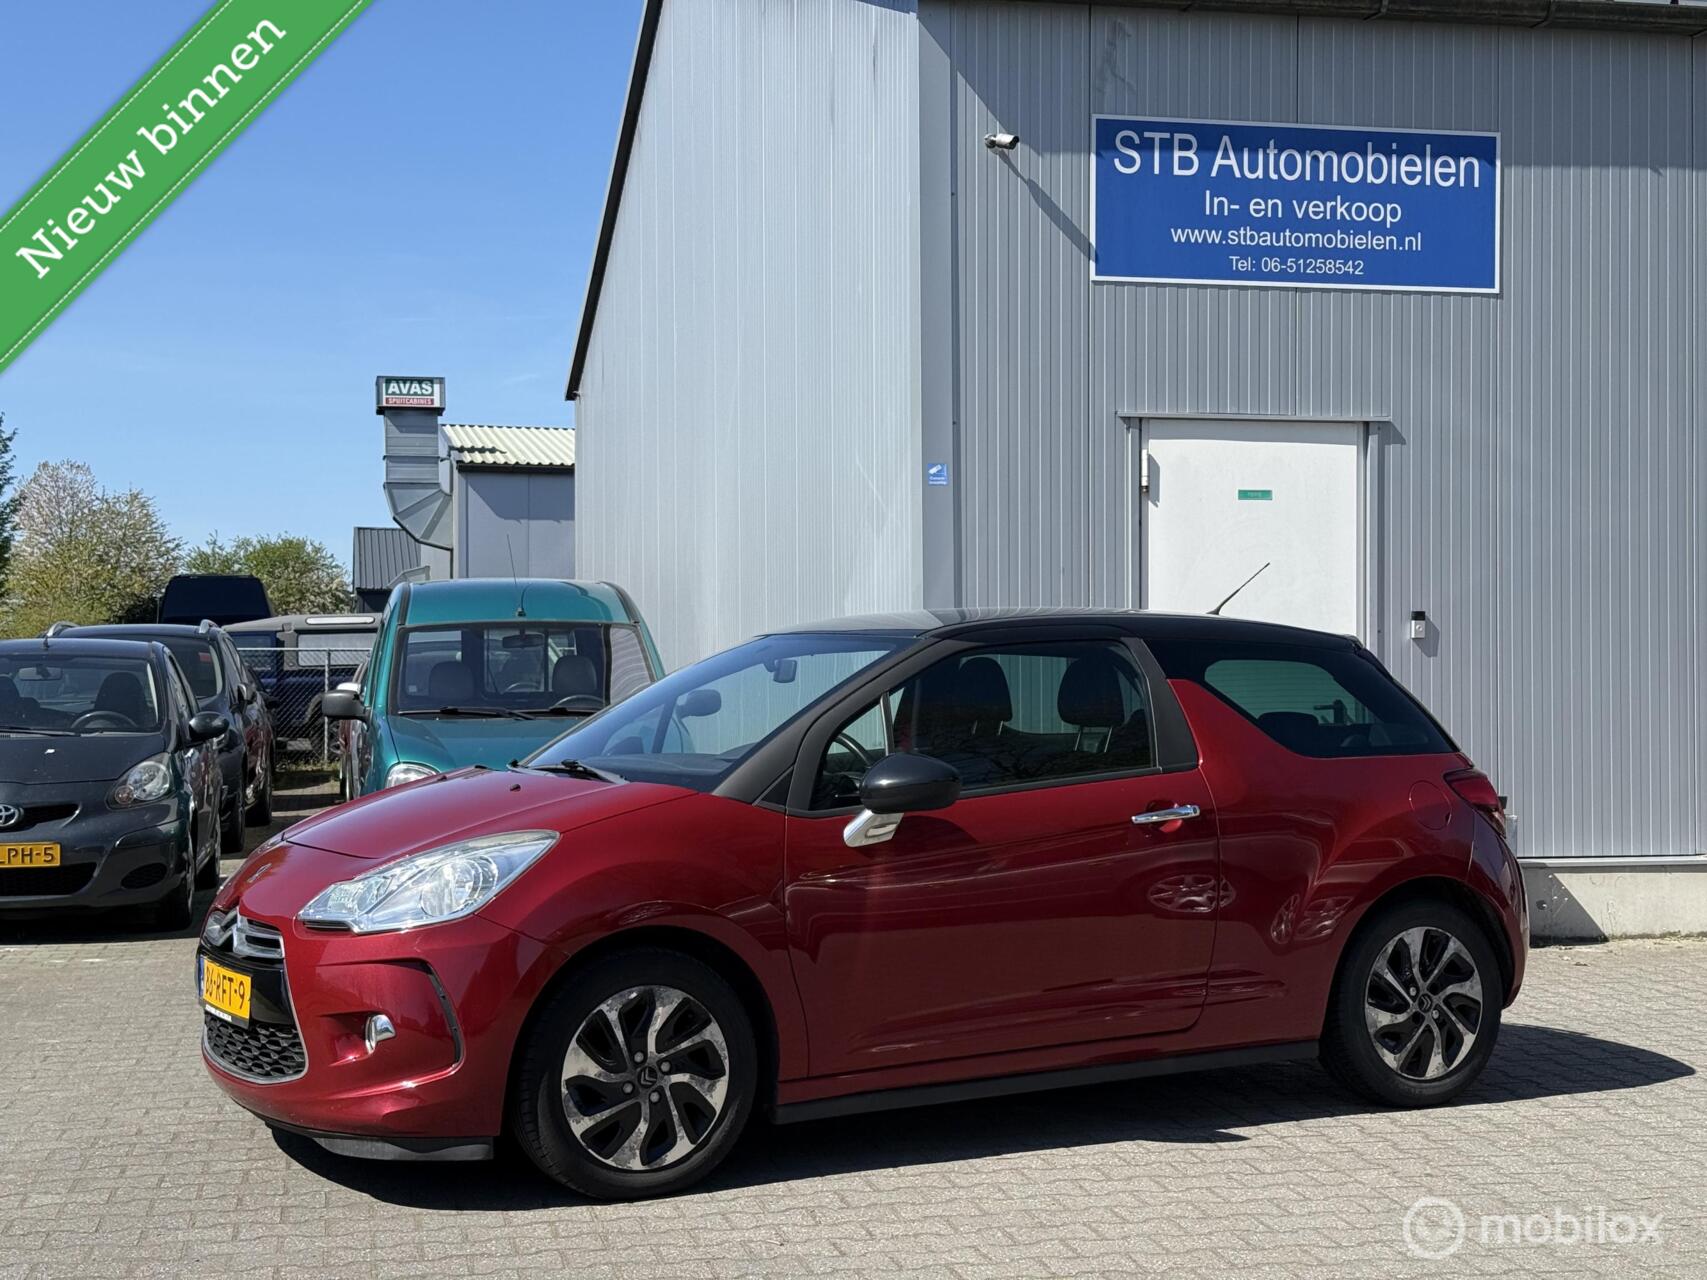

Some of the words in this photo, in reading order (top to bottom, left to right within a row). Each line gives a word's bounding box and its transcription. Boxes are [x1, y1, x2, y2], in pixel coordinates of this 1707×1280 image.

[1113, 130, 1200, 176] STB
[1211, 135, 1480, 188] Automobielen
[1204, 190, 1240, 217] In-
[1249, 197, 1283, 219] en
[1293, 196, 1402, 228] verkoop
[1170, 227, 1422, 252] www.stbautomobielen.nl
[1229, 256, 1257, 272] Tel:
[1261, 257, 1365, 276] 06-51258542
[387, 380, 432, 395] AVAS
